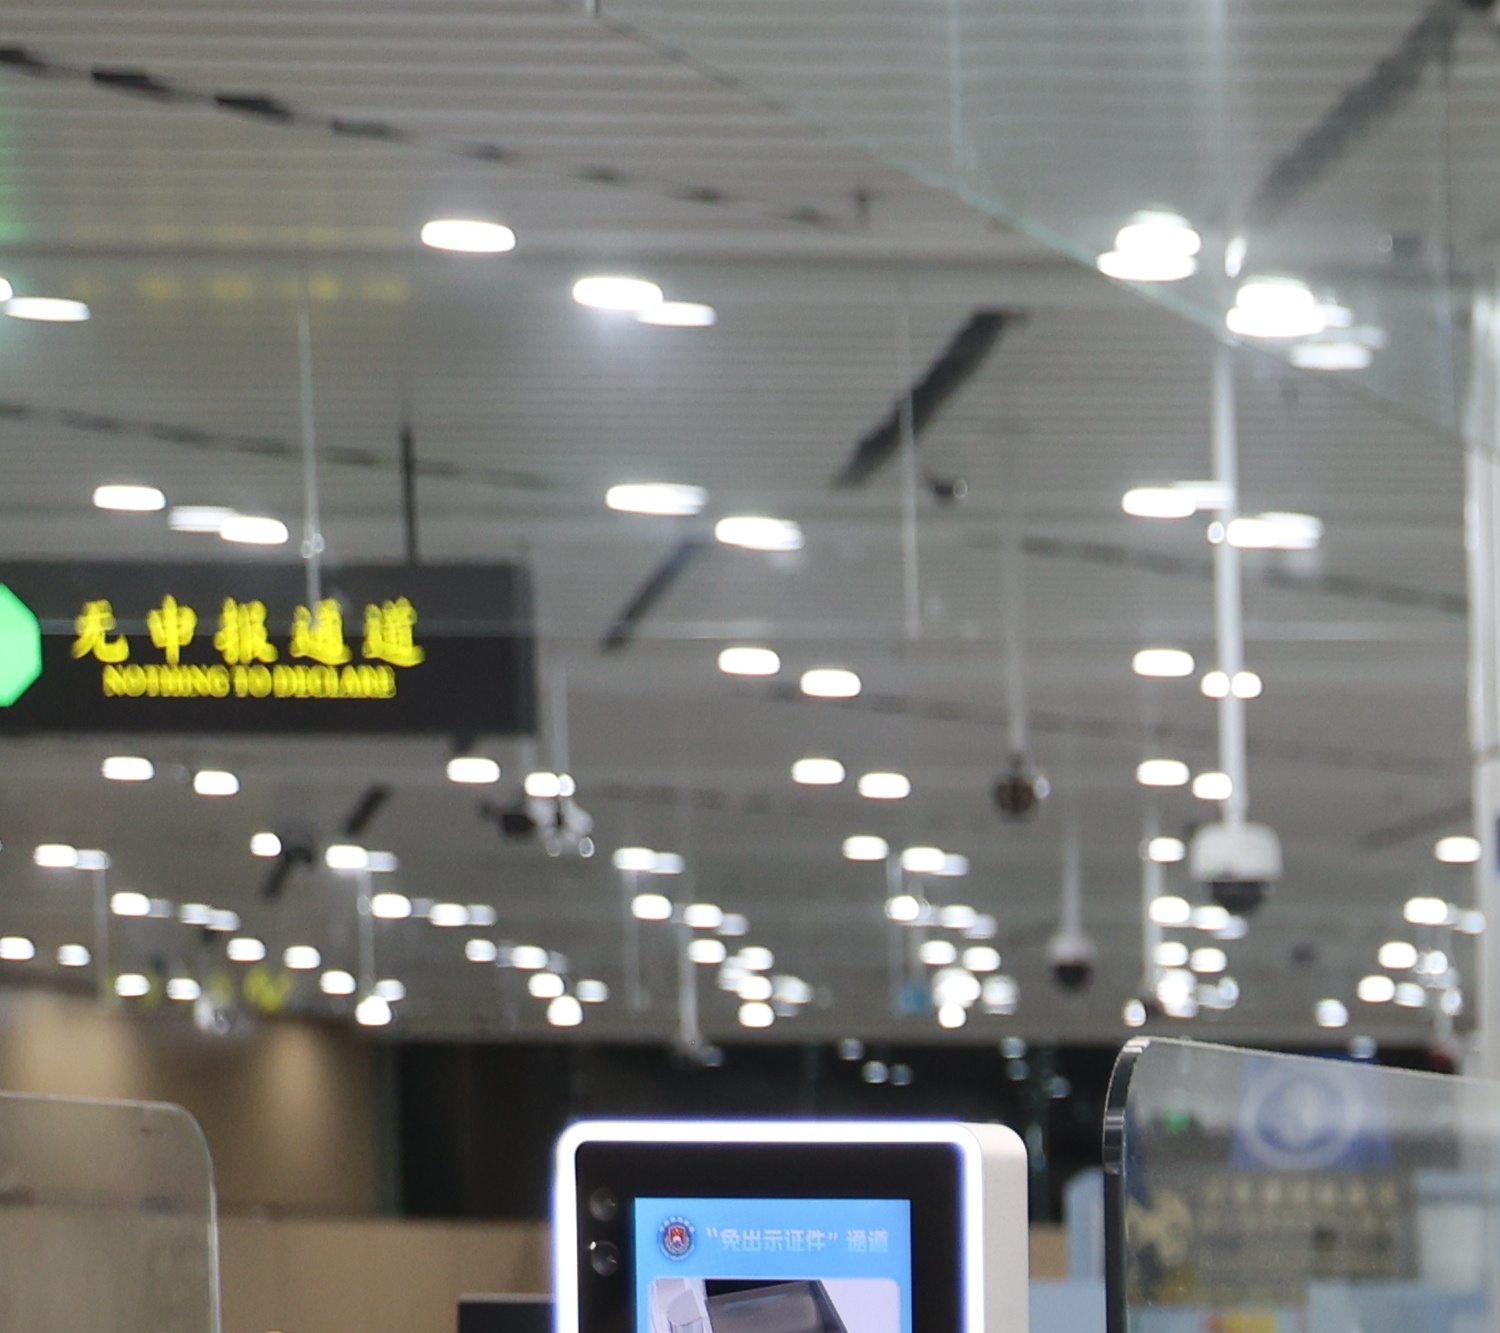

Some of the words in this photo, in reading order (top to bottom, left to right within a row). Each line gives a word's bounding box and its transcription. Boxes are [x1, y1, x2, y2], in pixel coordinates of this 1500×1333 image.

[71, 594, 426, 667] 无申报通道
